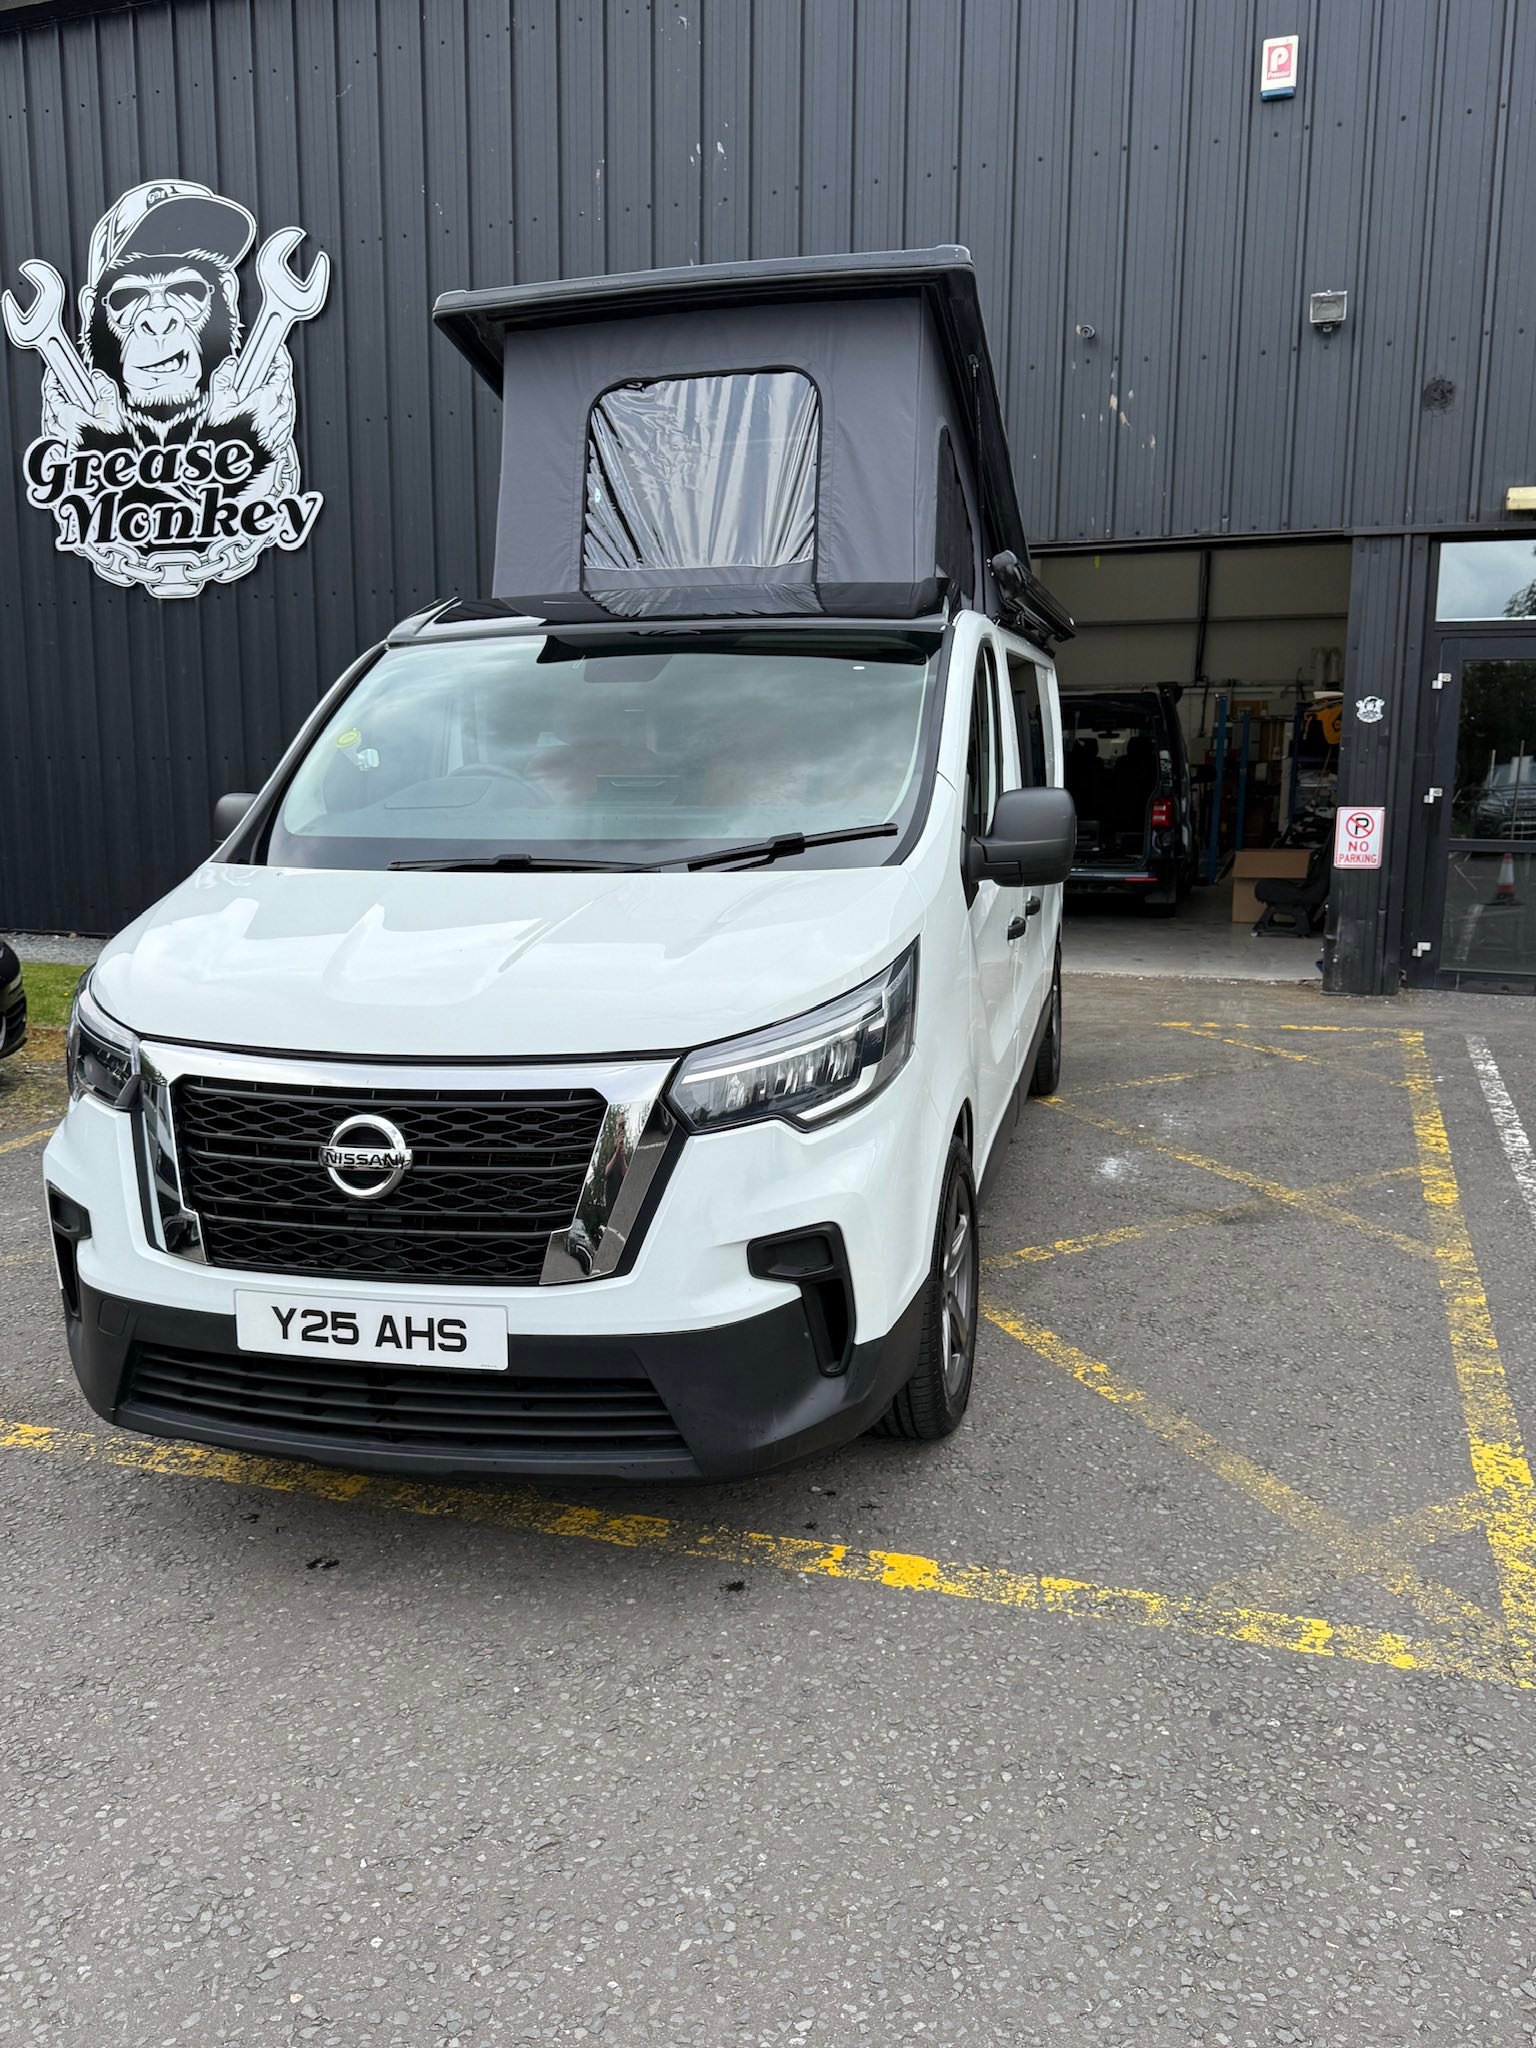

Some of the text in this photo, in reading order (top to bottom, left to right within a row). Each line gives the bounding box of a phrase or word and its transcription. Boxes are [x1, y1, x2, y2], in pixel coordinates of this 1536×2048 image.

[28, 439, 250, 502] Grease
[60, 487, 320, 546] Monkey
[1355, 817, 1369, 835] P
[1348, 841, 1369, 852] NO
[1338, 853, 1377, 864] PARKING
[325, 1151, 399, 1167] NISSAN
[271, 1305, 468, 1353] Y25 AHS
